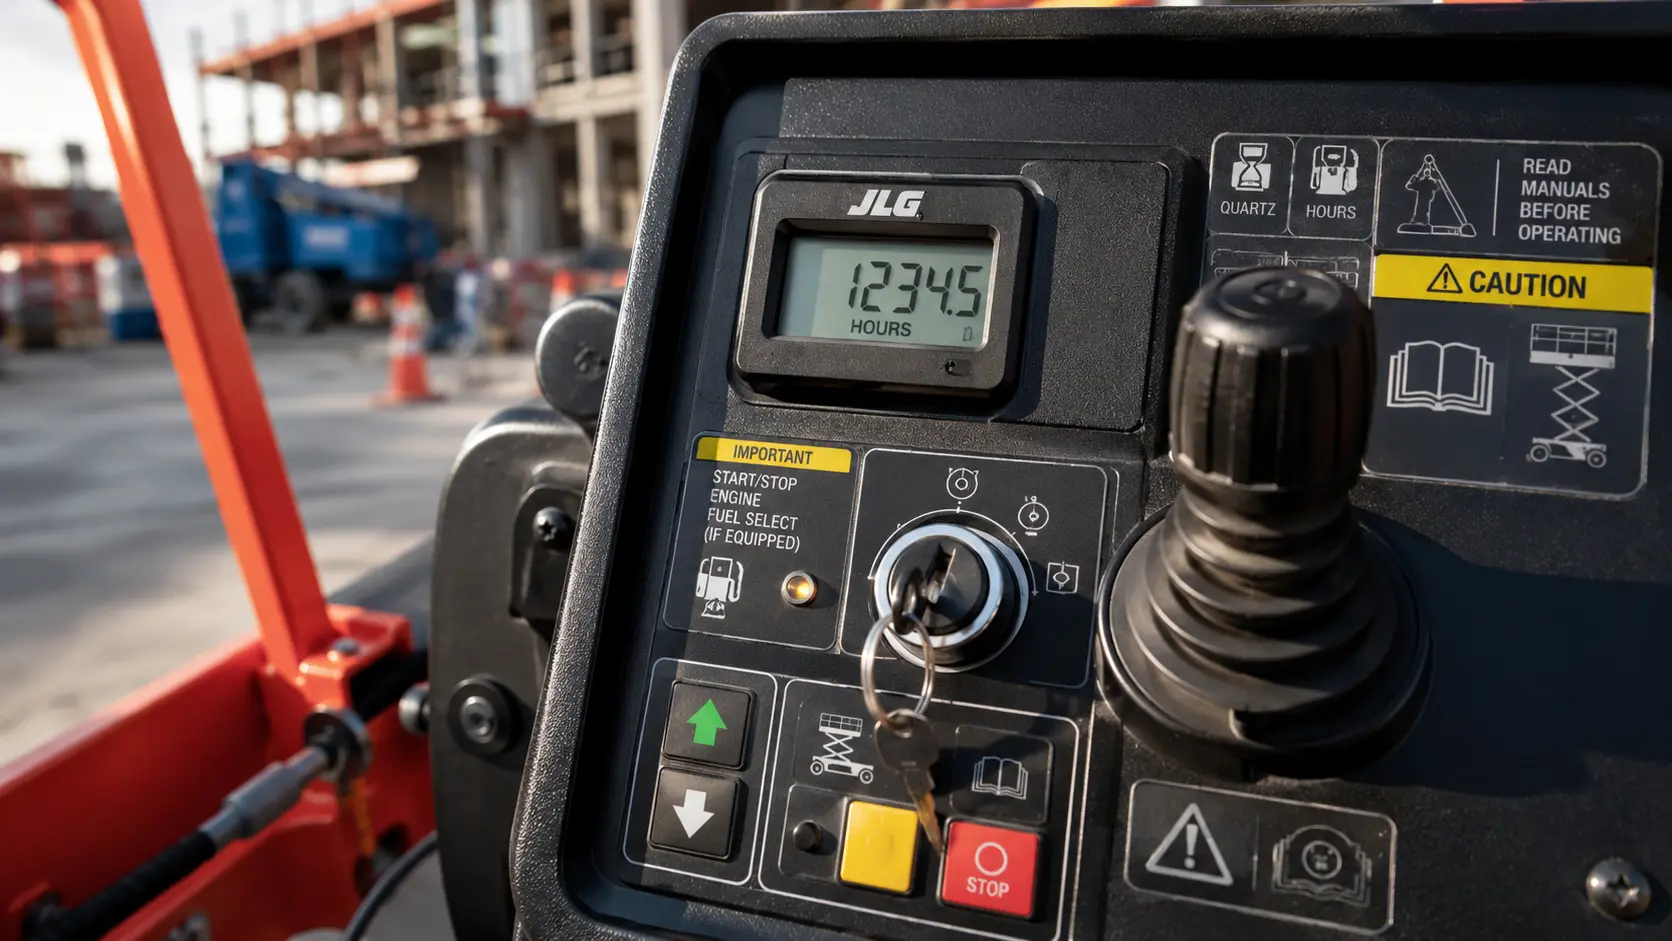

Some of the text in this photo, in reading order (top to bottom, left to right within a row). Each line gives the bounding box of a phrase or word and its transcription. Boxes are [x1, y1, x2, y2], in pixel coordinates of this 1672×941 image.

[1523, 158, 1572, 176] READ
[1521, 180, 1611, 199] MANUALS
[847, 189, 926, 217] JLG
[1220, 200, 1276, 217] QUARTZ
[1306, 204, 1357, 220] HOURS
[1519, 202, 1591, 221] BEFORE
[1518, 224, 1622, 245] OPERATING
[848, 260, 984, 318] 1234.5
[1469, 270, 1588, 300] CAUTION
[850, 319, 912, 337] HOURS
[733, 445, 813, 464] IMPORTANT
[712, 470, 797, 491] START/STOP
[710, 488, 762, 507] ENGINE
[707, 507, 798, 531] FUEL SELECT
[704, 526, 801, 553] (IF EQUIPPED)
[966, 875, 1010, 900] STOP
